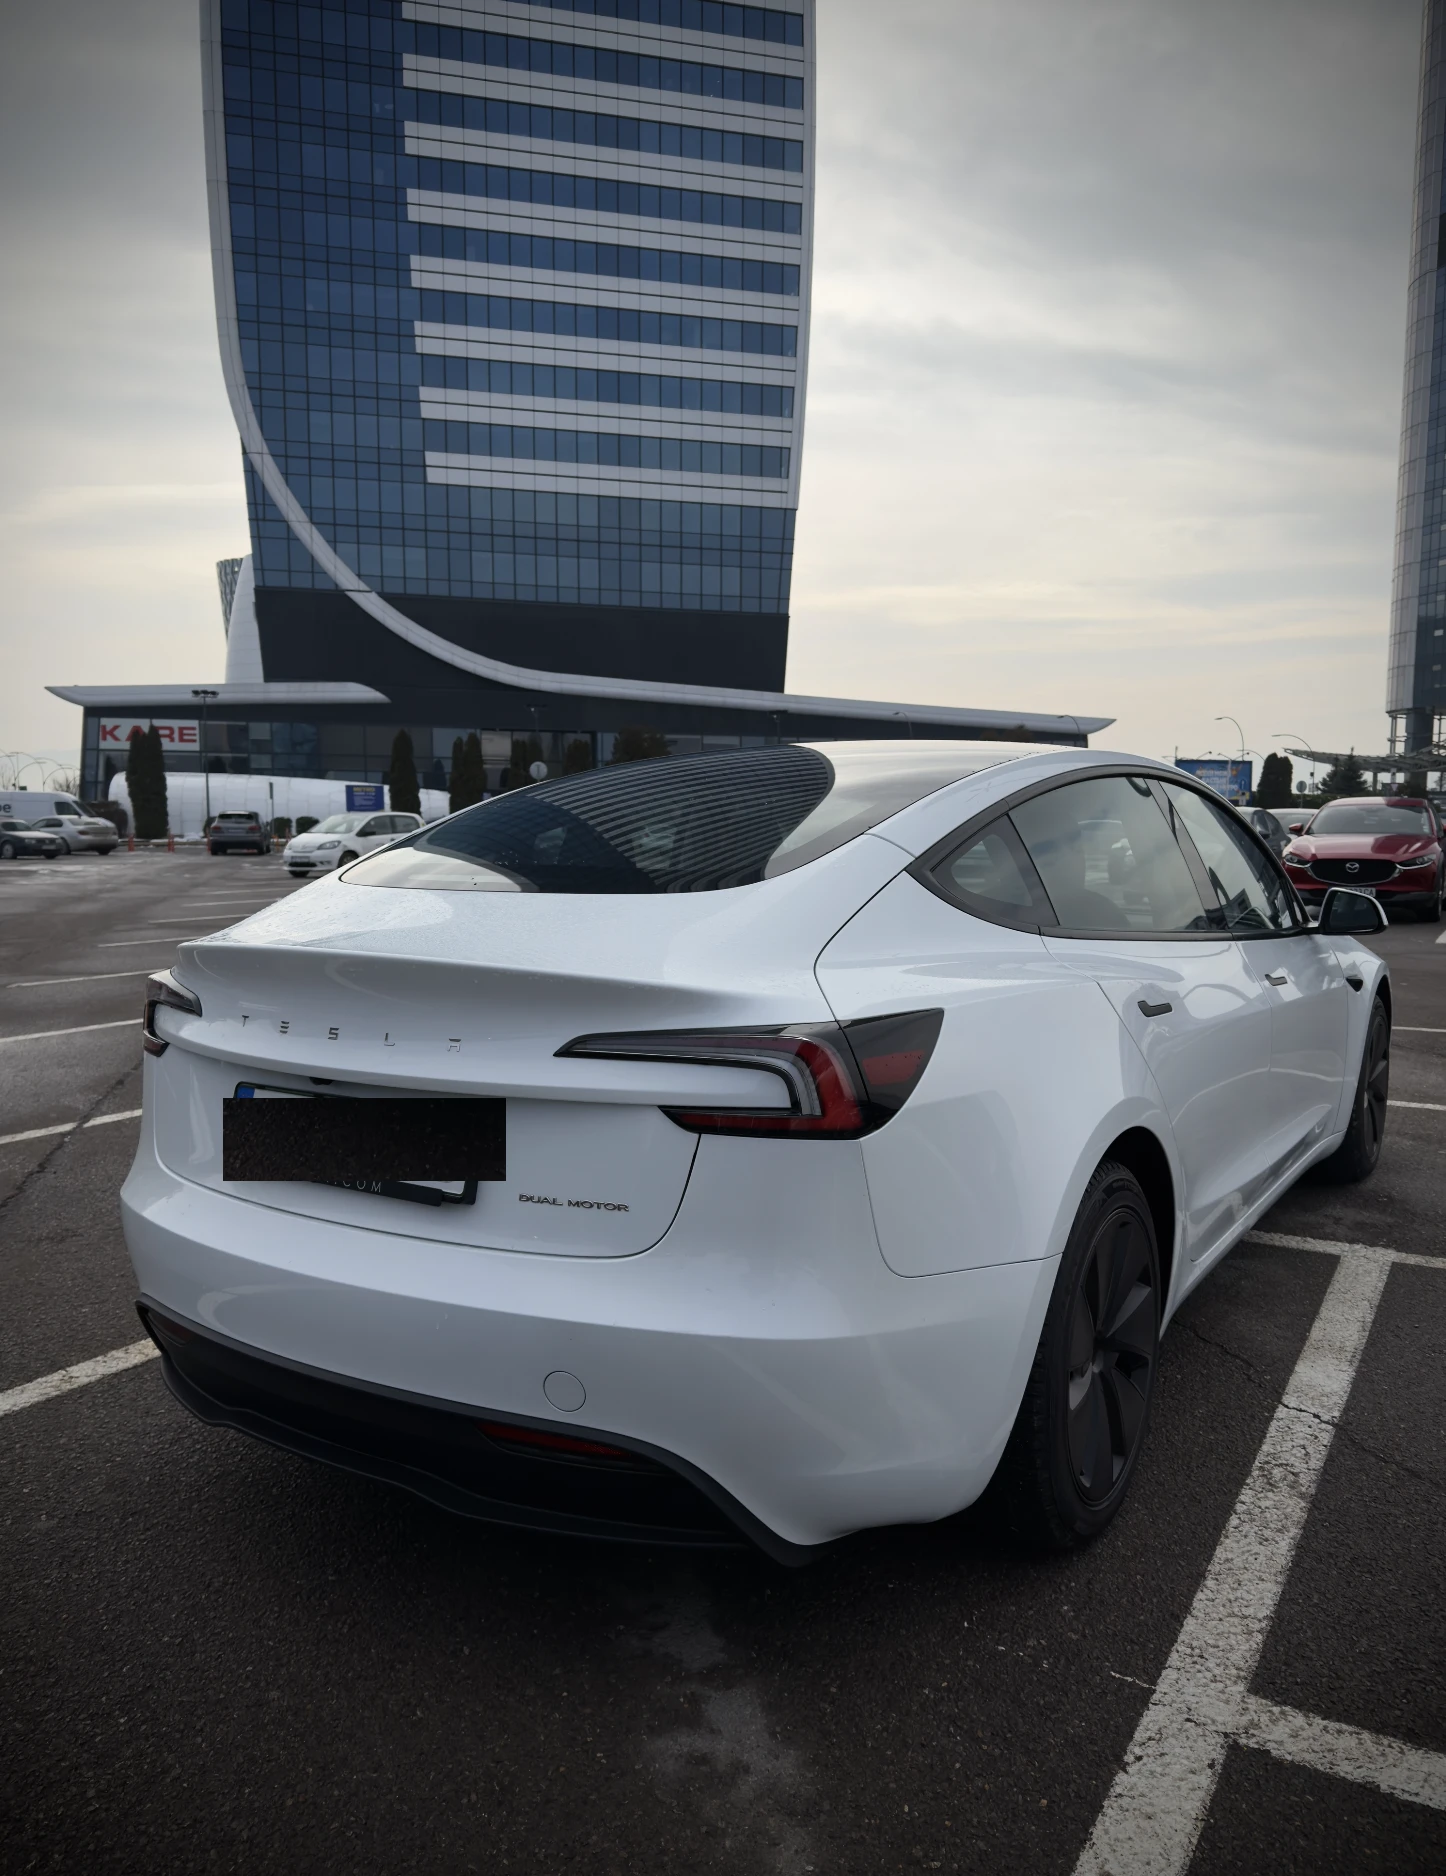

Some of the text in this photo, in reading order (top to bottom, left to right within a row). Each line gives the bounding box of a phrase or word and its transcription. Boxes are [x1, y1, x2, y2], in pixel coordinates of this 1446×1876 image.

[241, 1014, 462, 1053] TESLA
[519, 1193, 630, 1212] DUAL MOTOR
